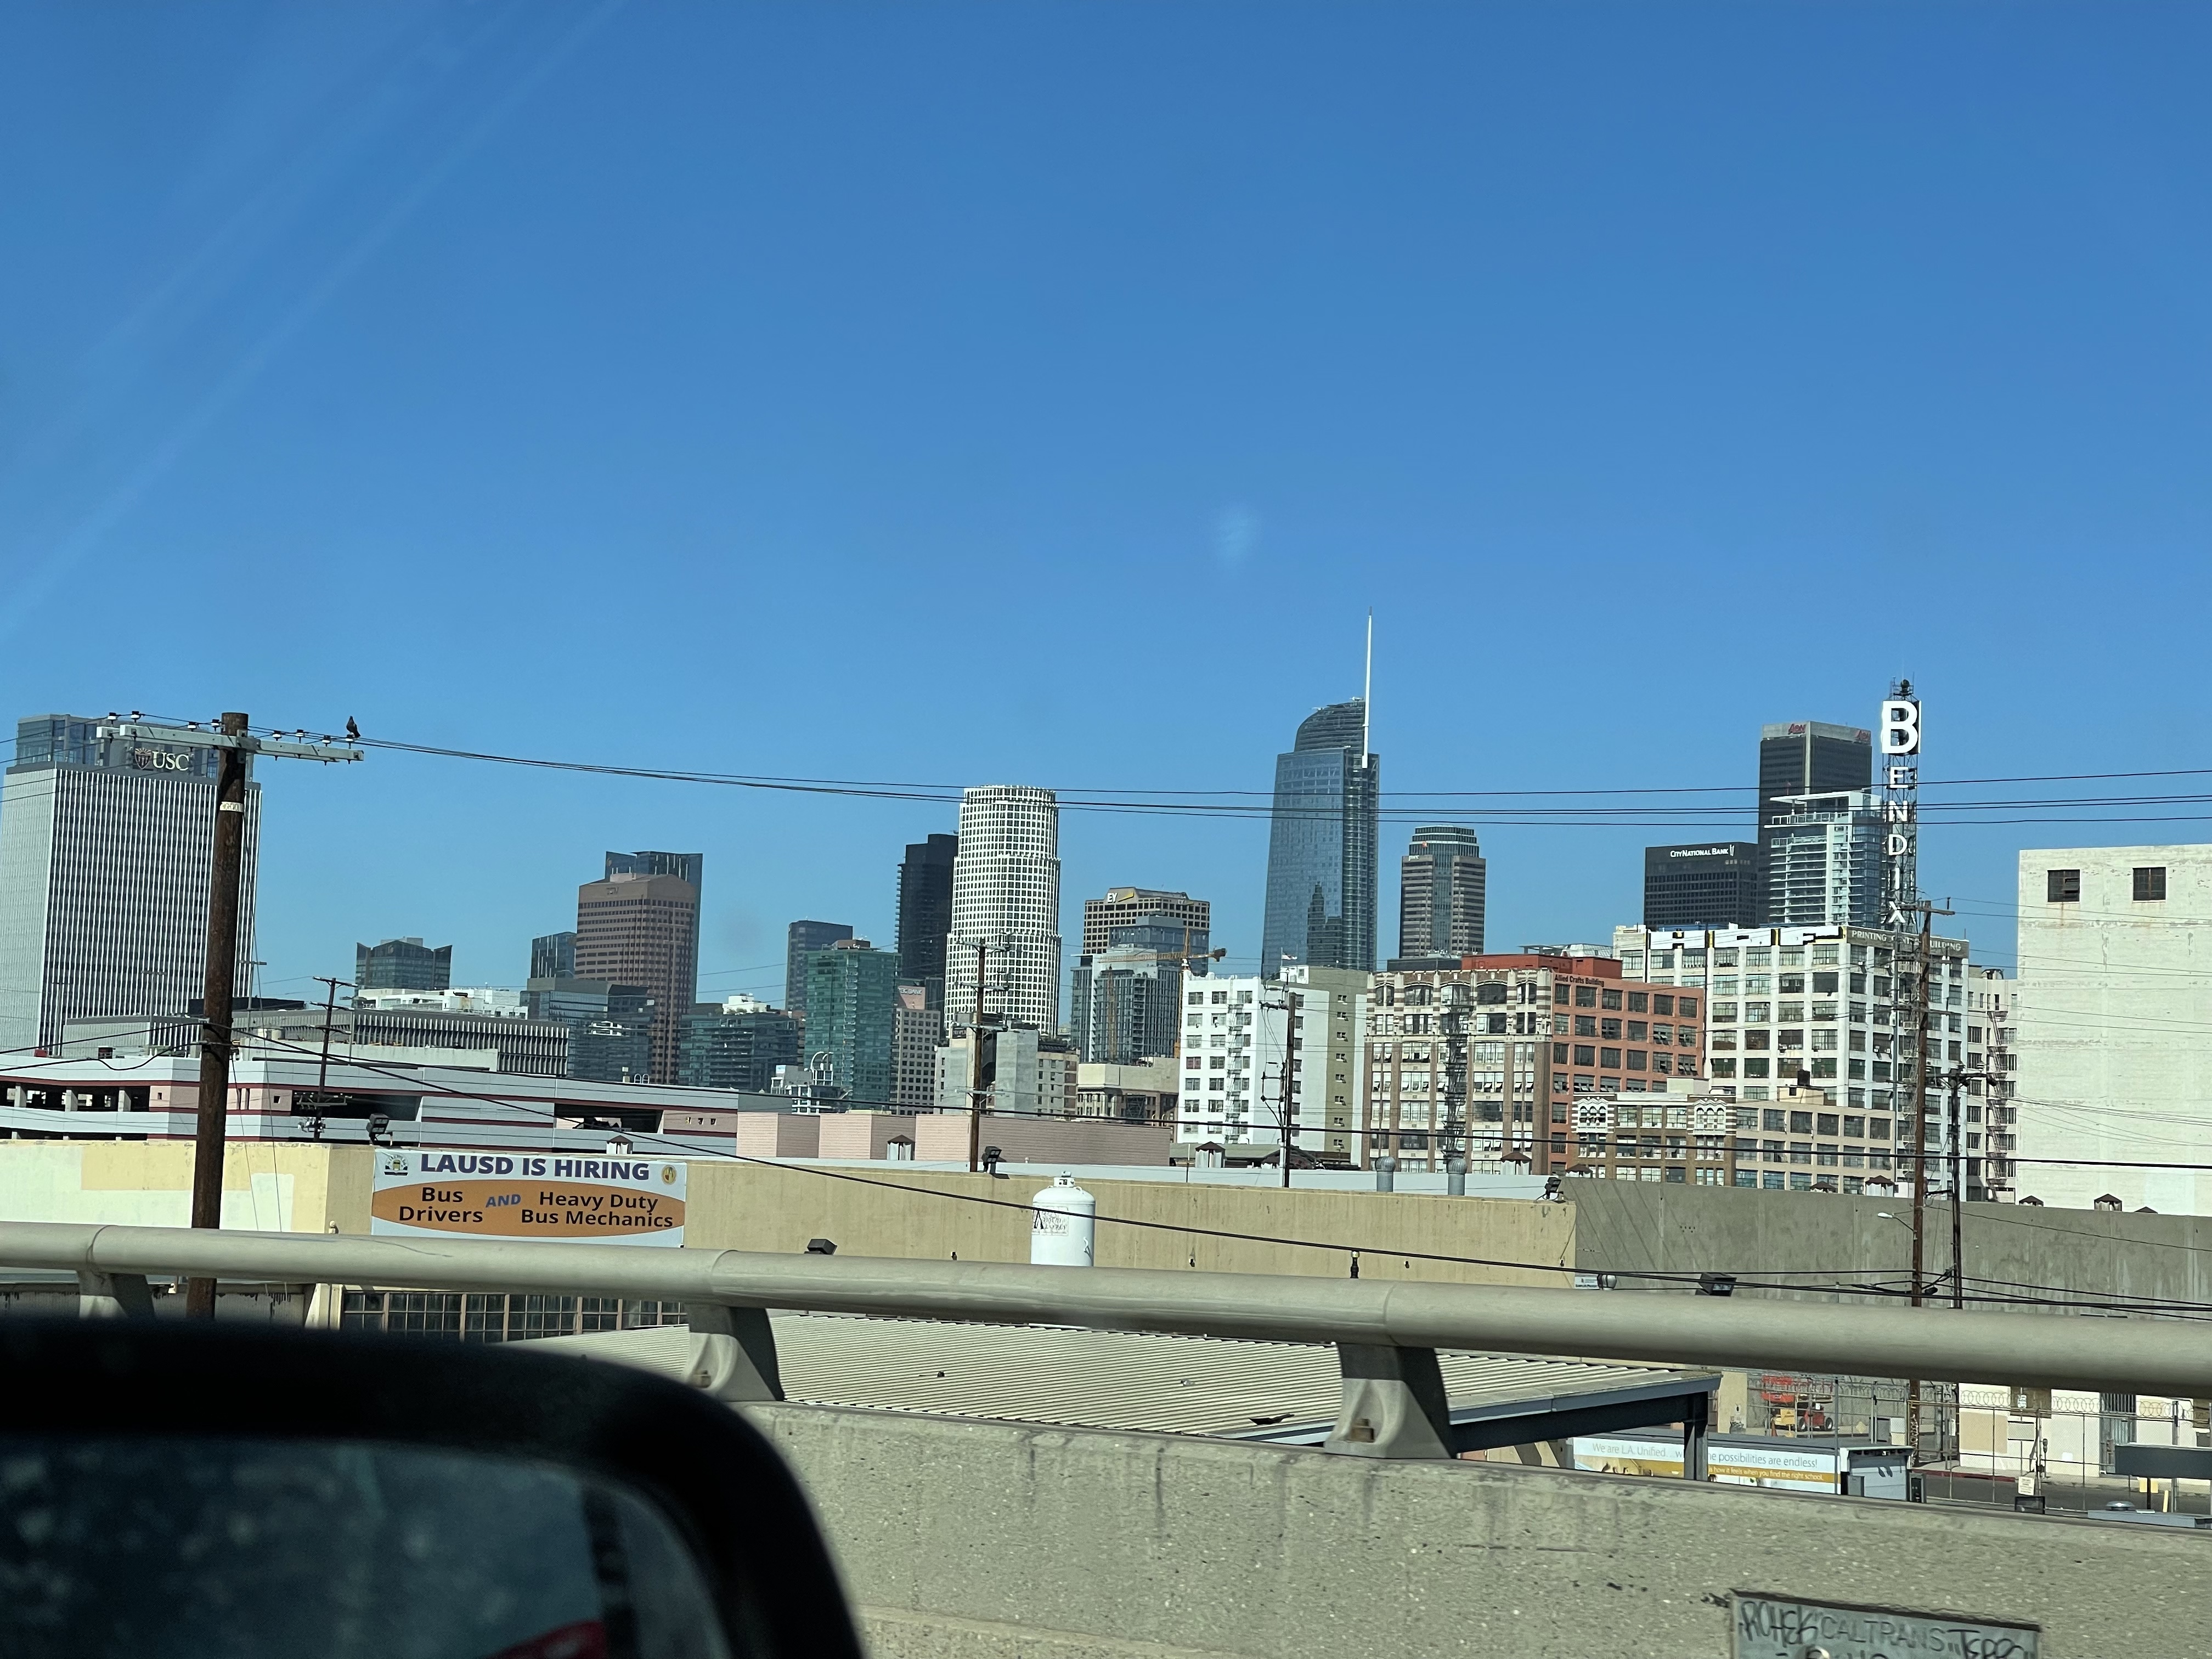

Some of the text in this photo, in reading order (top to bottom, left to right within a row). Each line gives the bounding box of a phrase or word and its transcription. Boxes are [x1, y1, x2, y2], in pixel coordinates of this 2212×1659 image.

[152, 751, 189, 771] USC
[1881, 701, 1919, 923] BENDIX
[1107, 893, 1118, 903] EY
[1852, 929, 1887, 941] PRINTING
[1929, 938, 1961, 951] UILDING
[1585, 978, 1604, 987] Building
[421, 1154, 650, 1181] LAUSD IS HIRING
[421, 1187, 463, 1203] Bus
[486, 1194, 521, 1207] AND
[540, 1192, 658, 1210] Heavy Duty
[399, 1206, 483, 1222] Drivers
[521, 1209, 673, 1227] Bus Mechanics
[1593, 1443, 1605, 1453] We
[1719, 1453, 1766, 1464] possibilities
[1768, 1457, 1781, 1465] are
[1784, 1457, 1817, 1468] endless!
